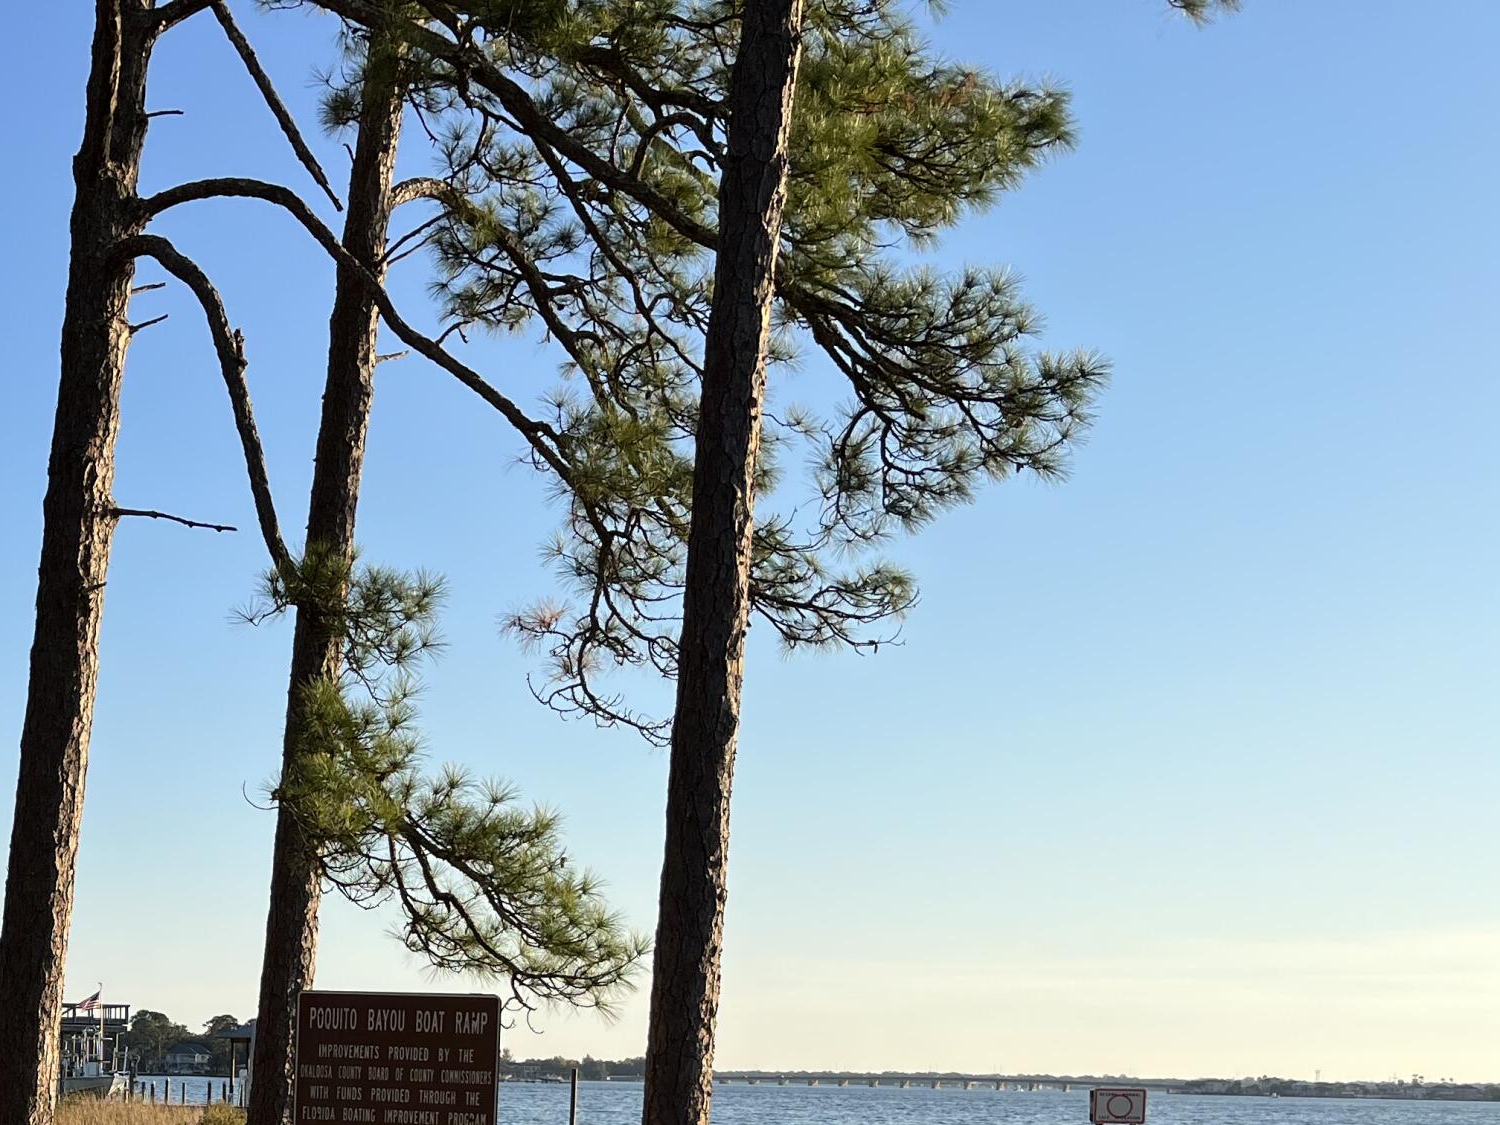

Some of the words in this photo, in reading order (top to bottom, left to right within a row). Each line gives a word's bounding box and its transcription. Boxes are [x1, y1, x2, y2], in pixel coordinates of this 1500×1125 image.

[309, 1007, 357, 1030] POQUITO
[367, 1009, 405, 1032] BAYOU
[415, 1010, 445, 1033] BOAT
[455, 1011, 488, 1035] RAMP
[318, 1044, 380, 1060] IMPROVEMENTS
[388, 1046, 429, 1061] PROVIDED
[438, 1048, 450, 1062] BY
[458, 1049, 474, 1063] THE
[300, 1064, 333, 1079] OKALOOSA
[338, 1065, 362, 1080] COUNTY
[368, 1066, 389, 1081] BOARD
[395, 1067, 404, 1082] OF
[409, 1068, 435, 1084] COUNTY
[440, 1069, 492, 1085] COMMISSIONERS
[309, 1085, 329, 1099] WITH
[336, 1086, 362, 1101] FUNDS
[370, 1088, 410, 1103] PROVIDED
[419, 1089, 456, 1105] THROUGH
[465, 1091, 480, 1106] THE
[302, 1106, 335, 1121] FLORIDA
[342, 1107, 376, 1122] BOATING
[384, 1109, 440, 1125] IMPROVEMENT
